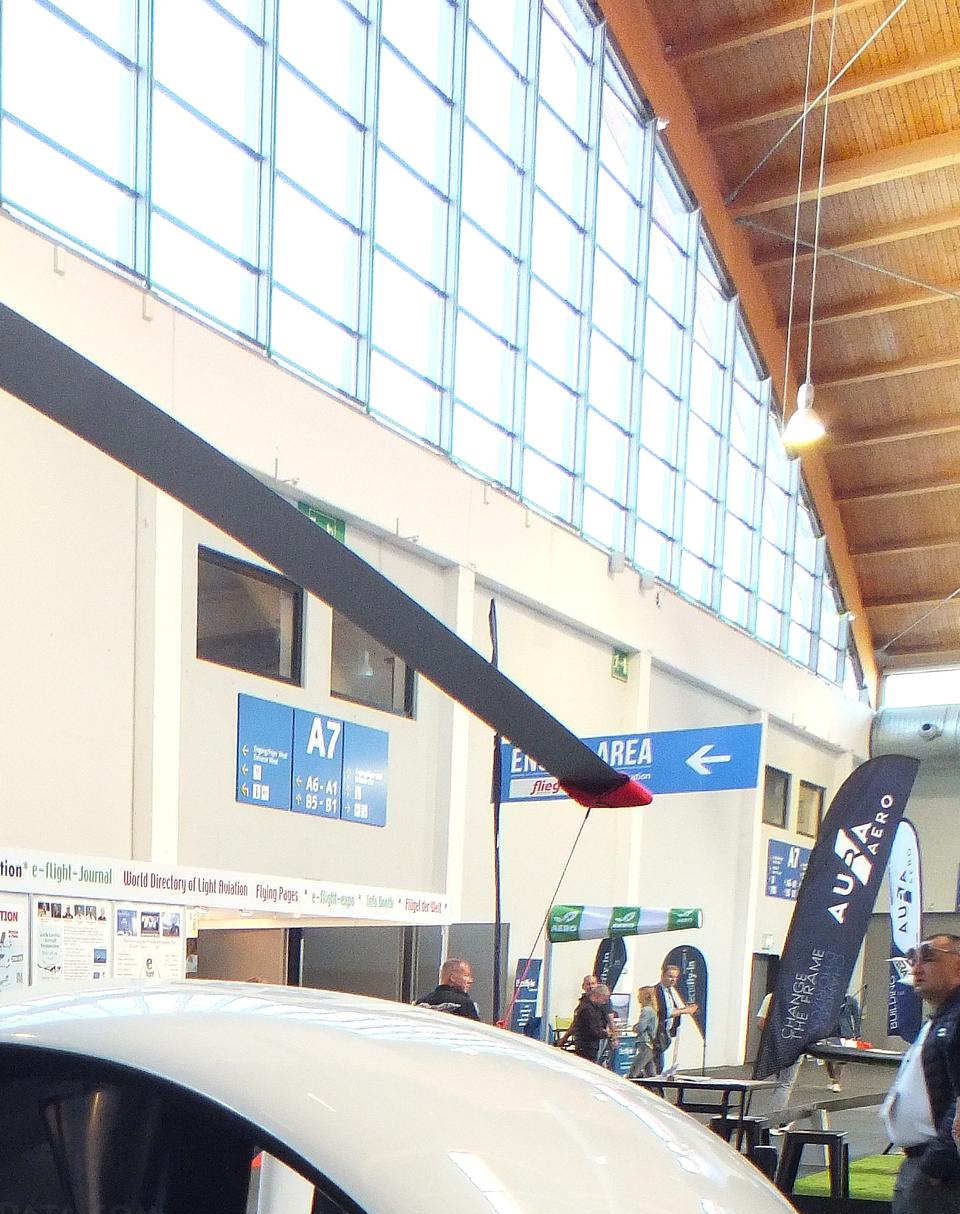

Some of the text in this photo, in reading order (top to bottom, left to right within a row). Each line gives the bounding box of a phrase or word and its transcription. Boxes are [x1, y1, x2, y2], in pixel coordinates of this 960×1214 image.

[307, 716, 341, 760] A7
[598, 738, 652, 767] AREA
[306, 776, 319, 791] A6
[326, 781, 337, 795] A1
[530, 780, 559, 795] flieg
[306, 794, 318, 810] B5
[326, 799, 337, 813] B1
[867, 795, 893, 855] AERO
[32, 862, 112, 885] e-flight-Journal
[123, 870, 248, 896] World Directory of Light Aviation
[827, 822, 873, 924] AURA
[256, 885, 298, 903] Flying Pages
[801, 949, 825, 1004] FRAME
[782, 973, 808, 1039] CHANGE
[791, 1012, 809, 1039] THE
